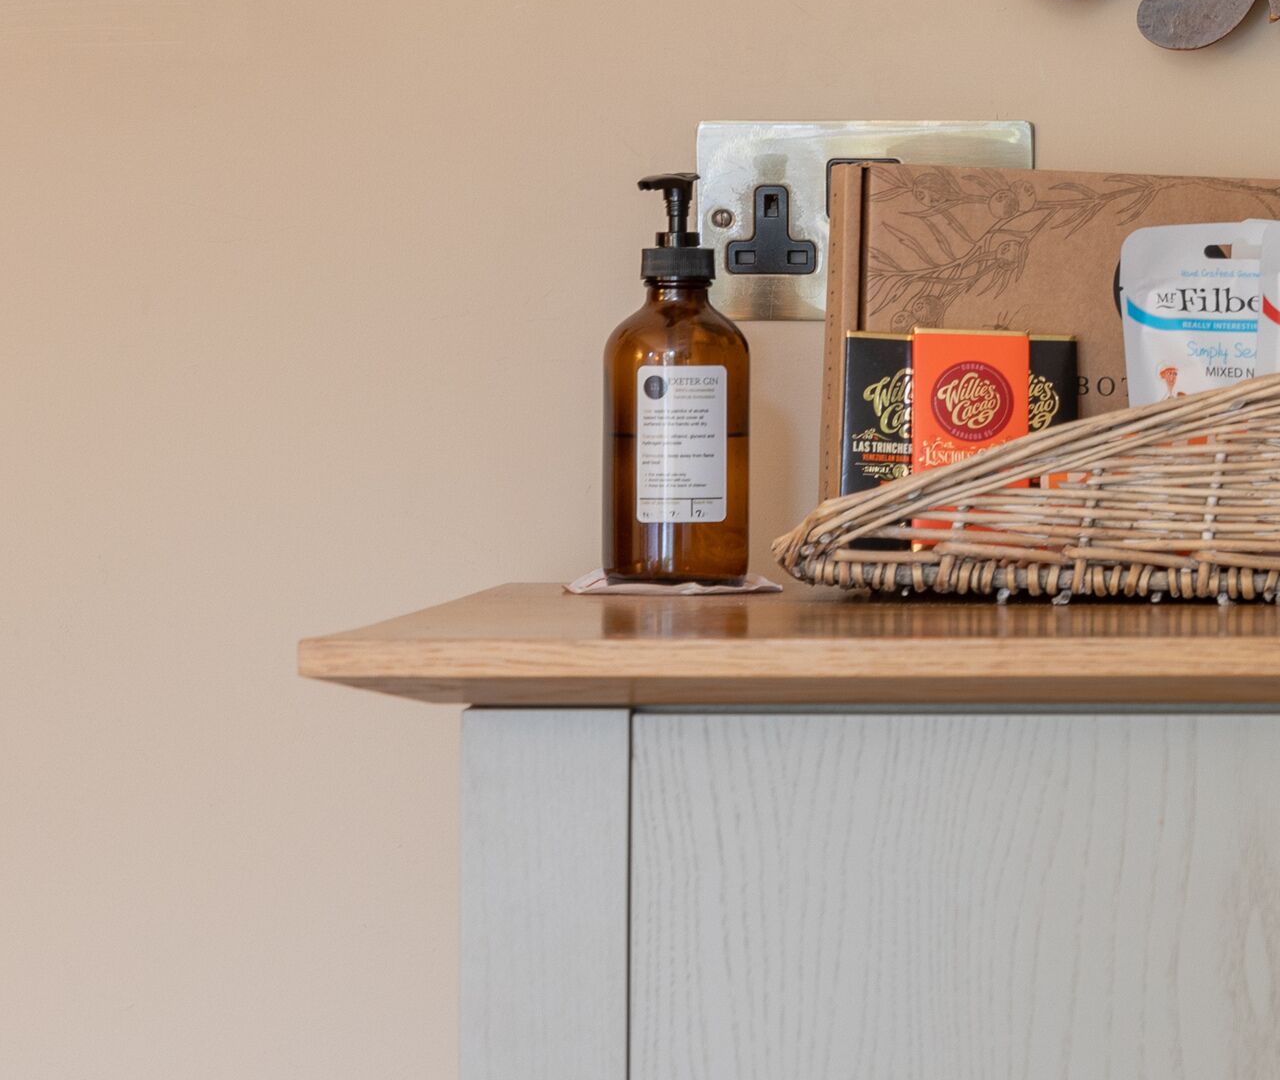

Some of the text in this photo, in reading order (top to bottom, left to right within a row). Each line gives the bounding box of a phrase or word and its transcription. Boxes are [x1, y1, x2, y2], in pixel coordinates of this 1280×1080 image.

[1176, 287, 1259, 313] Filbe
[1182, 321, 1257, 331] REALLY INTERESTI
[1205, 366, 1243, 378] MIXED
[703, 376, 719, 386] GIN
[852, 441, 912, 455] LAS TRINCHER
